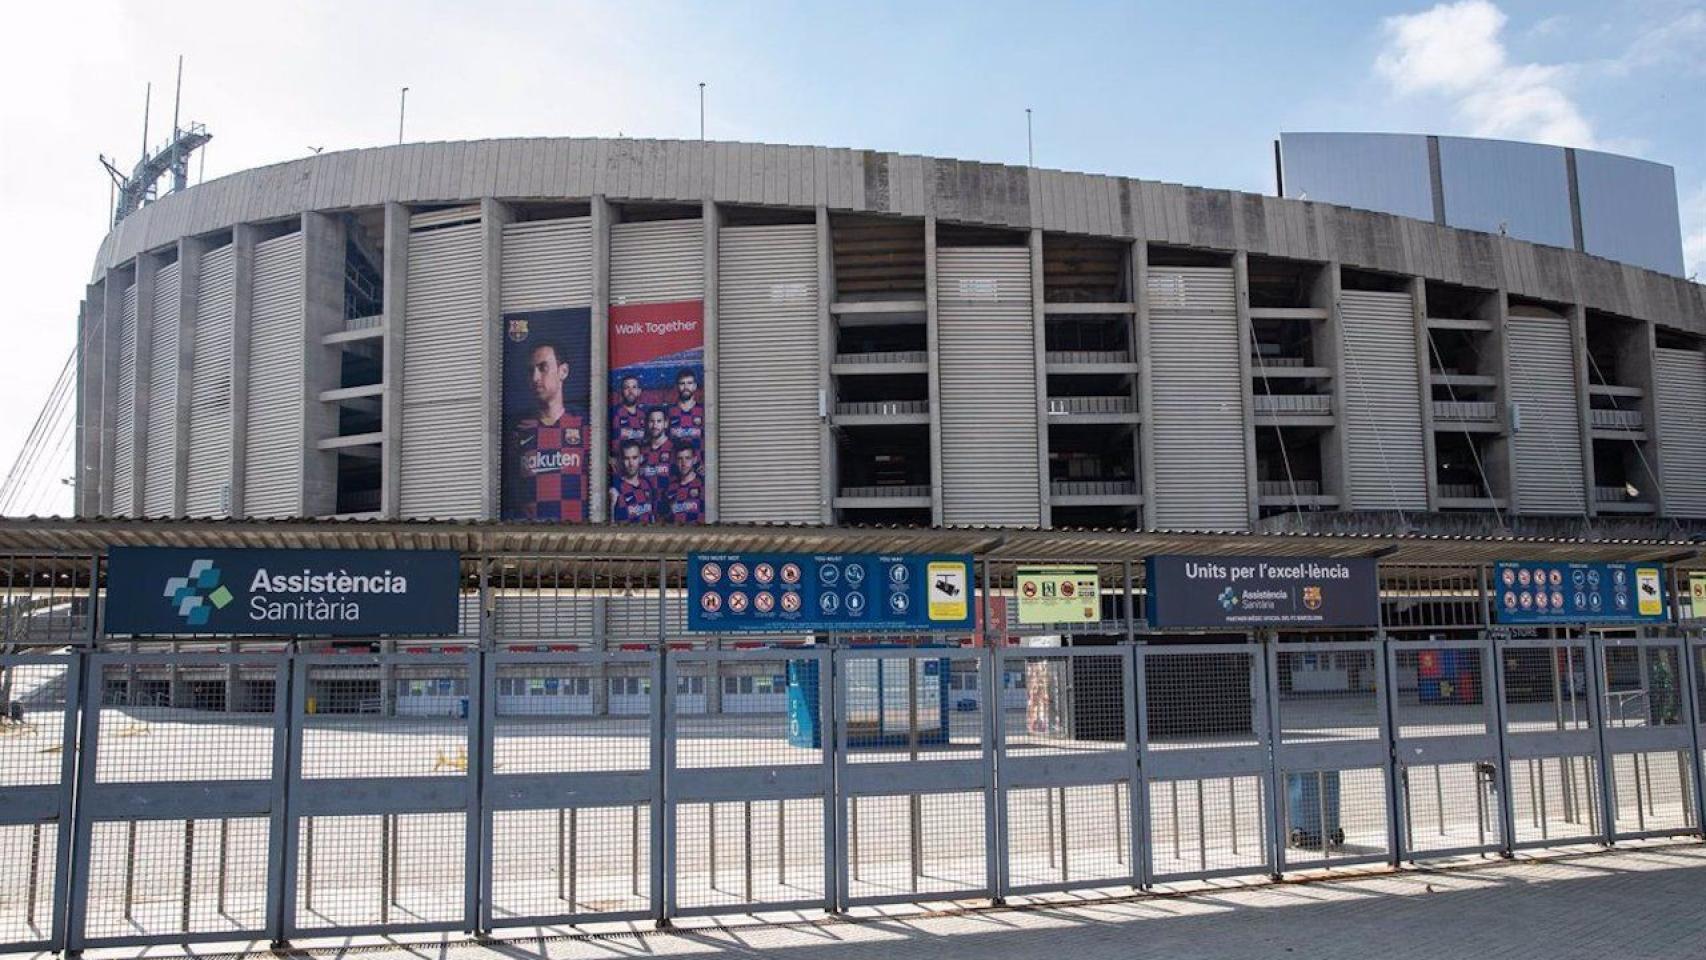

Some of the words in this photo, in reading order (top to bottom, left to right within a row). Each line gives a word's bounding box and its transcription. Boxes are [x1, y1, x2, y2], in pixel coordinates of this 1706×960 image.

[615, 323, 643, 335] Walk
[645, 320, 698, 336] Together
[249, 568, 407, 593] Assistència
[1185, 563, 1227, 578] Units
[1230, 566, 1255, 581] per
[250, 595, 360, 620] Sanitària
